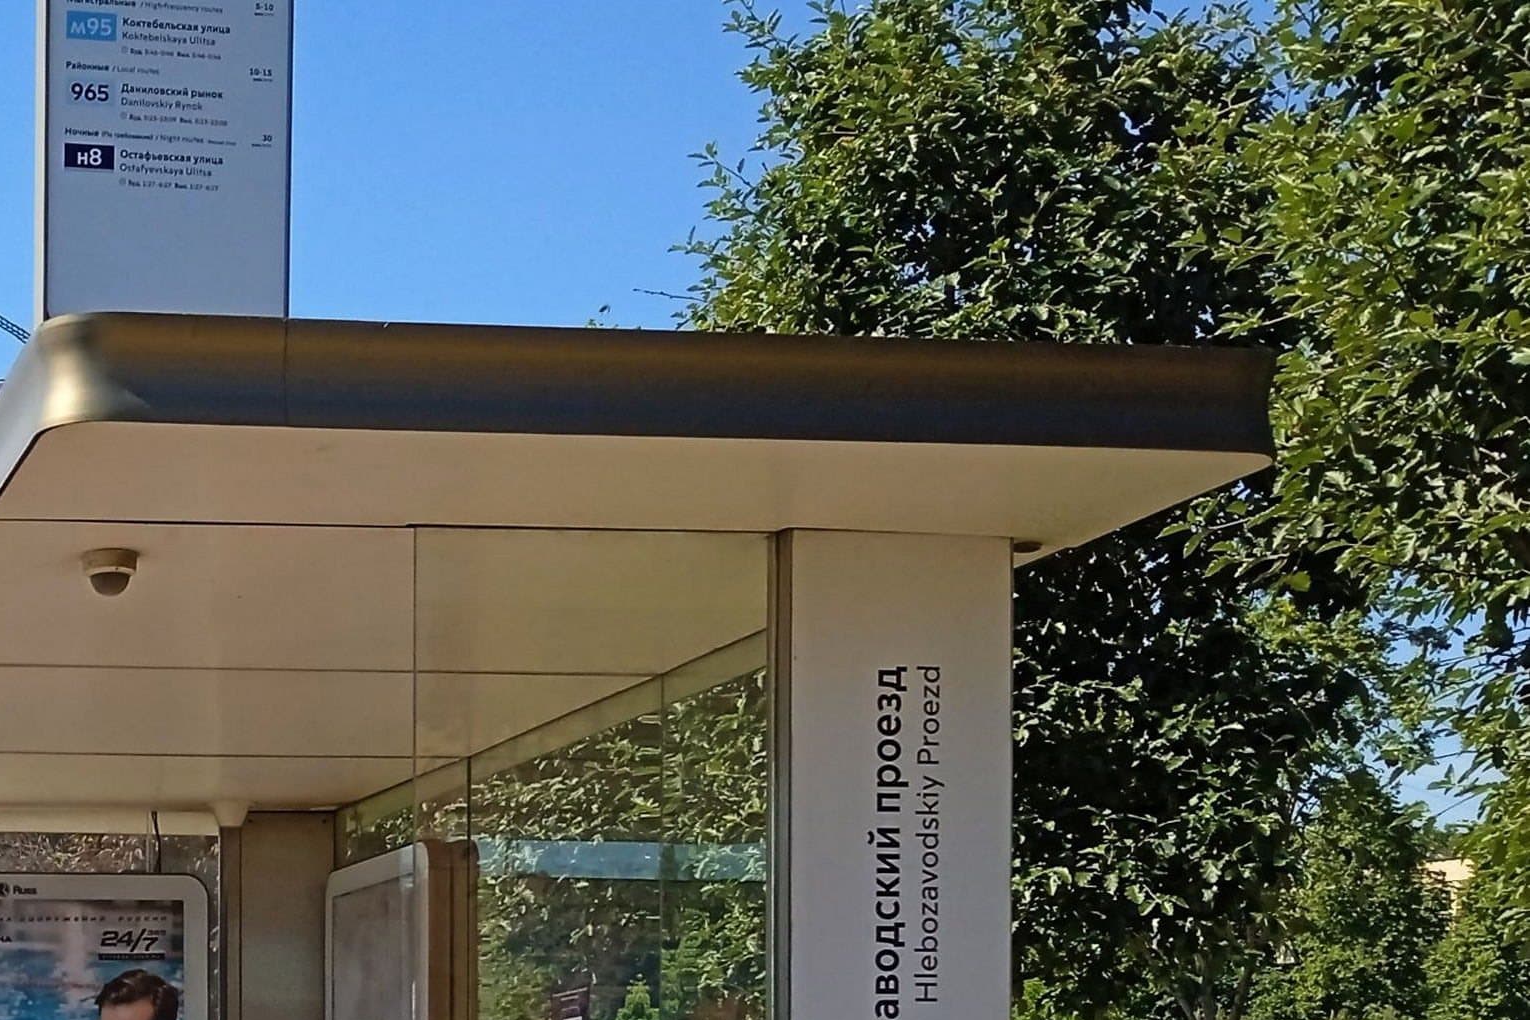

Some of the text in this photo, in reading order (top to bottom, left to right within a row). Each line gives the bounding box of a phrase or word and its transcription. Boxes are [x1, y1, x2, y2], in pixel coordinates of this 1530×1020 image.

[122, 17, 231, 34] Коктебельская улица
[122, 31, 216, 46] Koktebelskaya Ulitsa
[71, 82, 110, 102] 965
[120, 83, 223, 99] Даниловский рынок
[120, 97, 203, 111] Danilovskiy Rynok
[120, 149, 224, 165] Остафьевская улица
[185, 167, 213, 177] Ulitsa
[876, 666, 909, 813] проезд
[913, 666, 945, 1003] Hlebozavodskiy Proezd
[99, 928, 160, 953] 24/7
